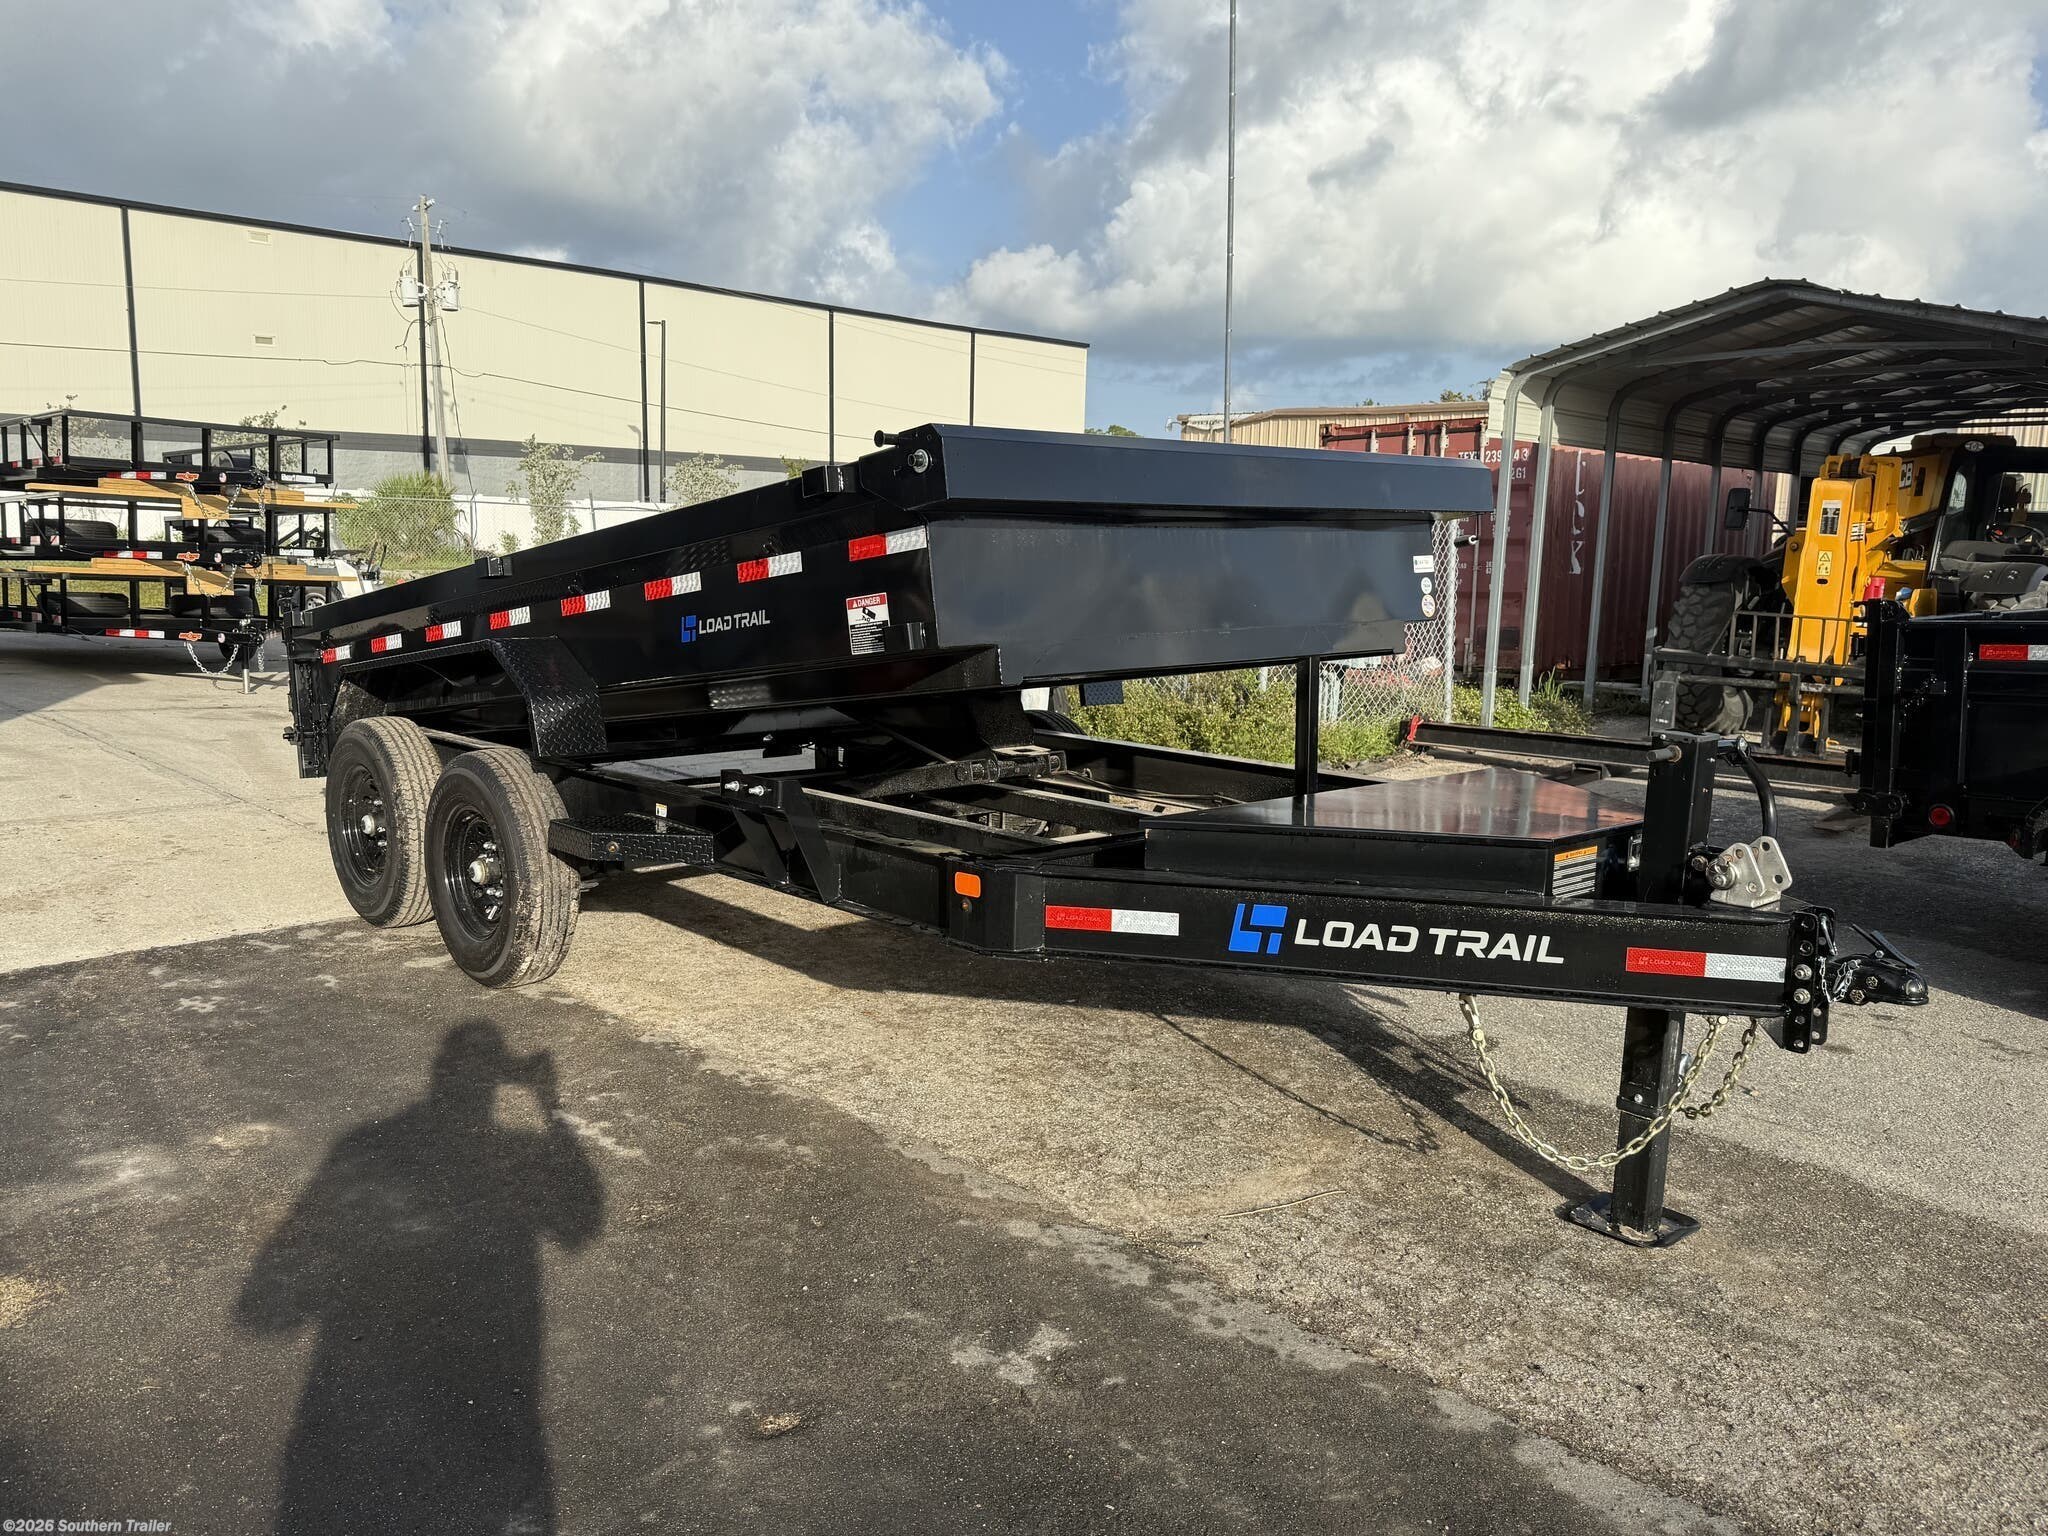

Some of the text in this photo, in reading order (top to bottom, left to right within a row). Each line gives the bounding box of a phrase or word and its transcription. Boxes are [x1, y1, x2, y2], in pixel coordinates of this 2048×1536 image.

[857, 596, 881, 608] DANGER
[699, 609, 771, 635] LOAD TRAIL
[1294, 918, 1565, 964] LOAD TRAIL
